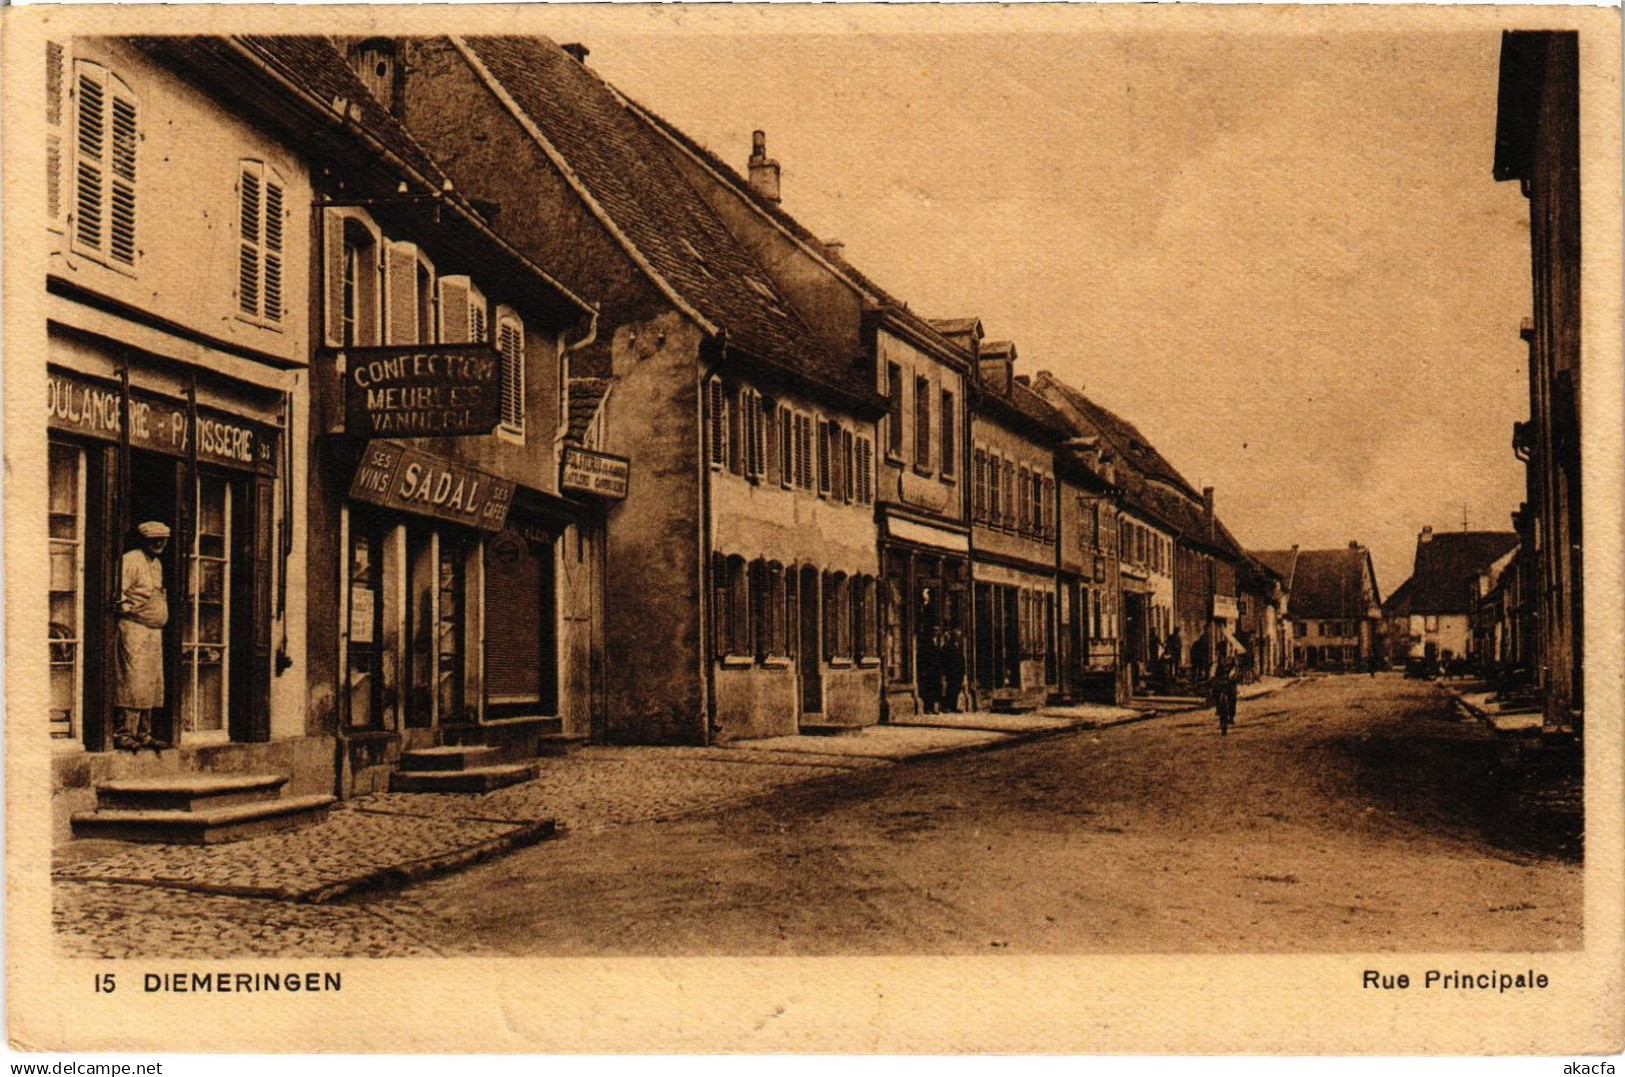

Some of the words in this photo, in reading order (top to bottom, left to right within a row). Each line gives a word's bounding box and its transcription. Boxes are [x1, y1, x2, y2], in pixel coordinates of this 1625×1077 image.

[353, 353, 494, 387] CONFECTION
[367, 385, 482, 410] MEUBLES
[370, 409, 478, 431] VANNERI
[372, 451, 391, 468] SES
[359, 467, 390, 493] VINS
[401, 462, 479, 513] SADAL
[493, 486, 508, 501] SES
